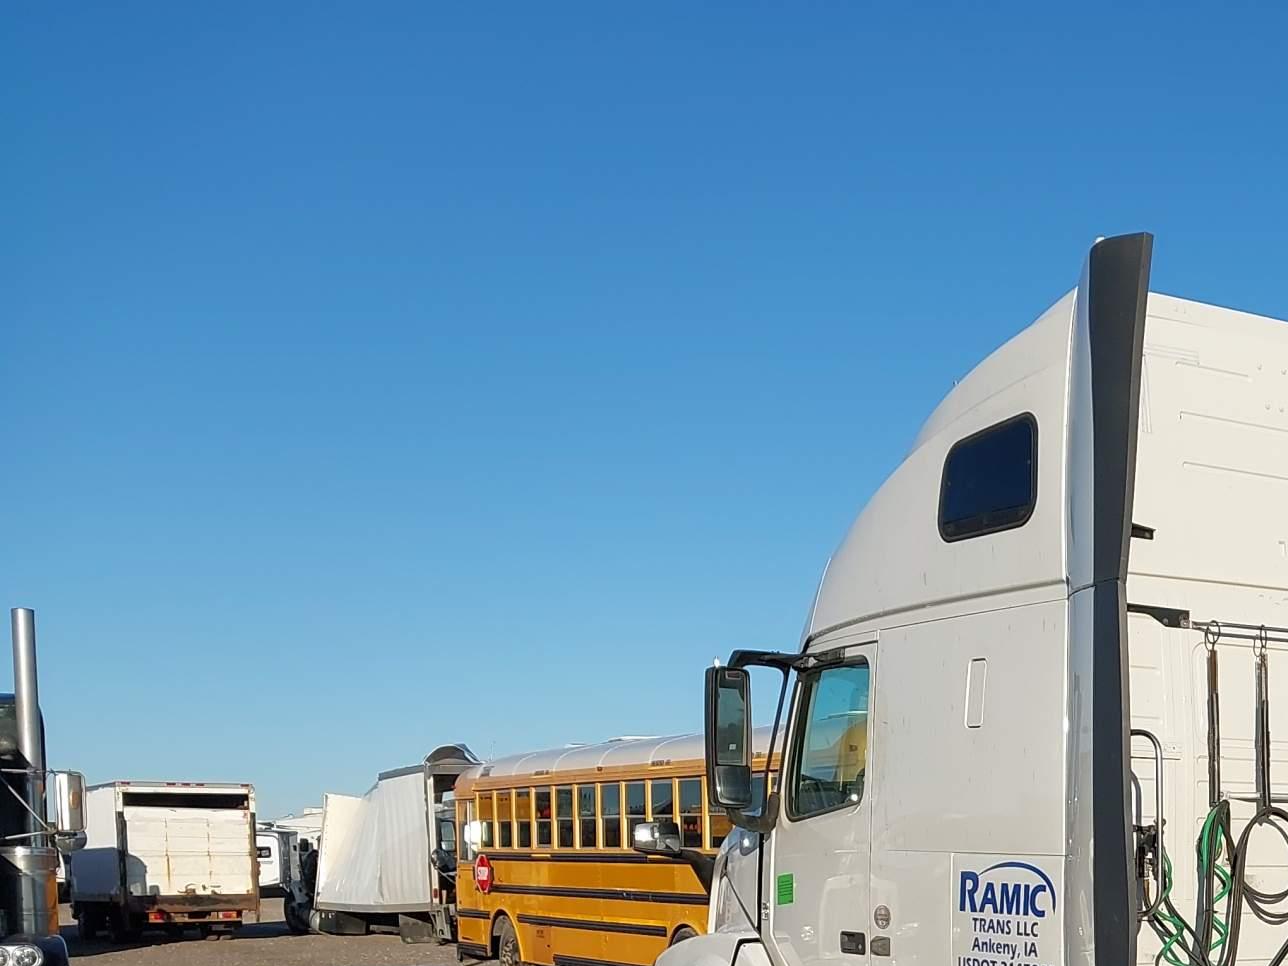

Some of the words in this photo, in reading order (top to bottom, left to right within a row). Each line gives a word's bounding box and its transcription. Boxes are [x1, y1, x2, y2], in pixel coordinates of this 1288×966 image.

[959, 870, 1047, 918] RAMIC
[972, 917, 1011, 935] TRANS
[1016, 920, 1039, 938] LLC
[971, 937, 1021, 960] Ankeny,
[1024, 941, 1038, 958] IA
